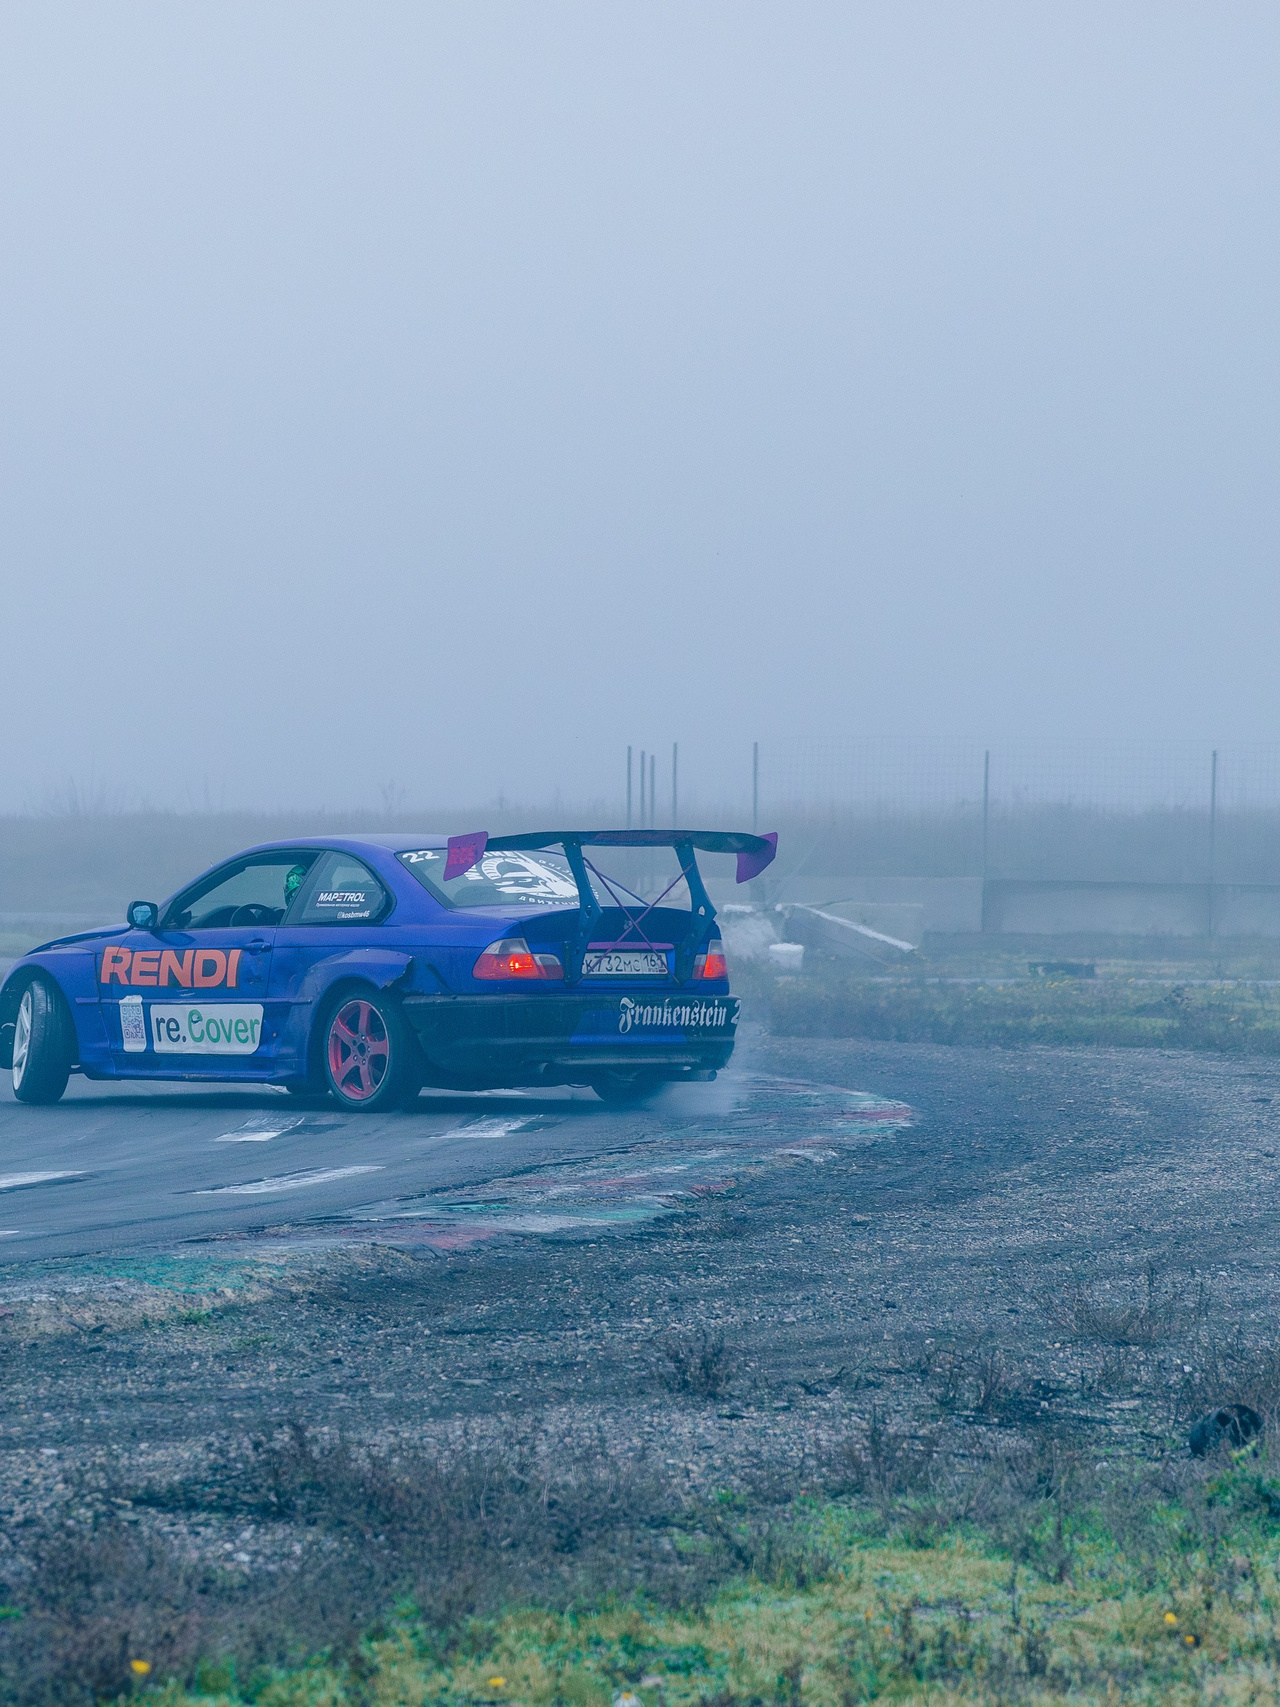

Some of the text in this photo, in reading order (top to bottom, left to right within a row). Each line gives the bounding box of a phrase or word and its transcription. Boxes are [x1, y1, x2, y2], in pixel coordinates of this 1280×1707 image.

[402, 850, 439, 864] 22
[317, 892, 365, 902] MAPETROL
[101, 946, 242, 988] RENDI
[619, 997, 727, 1034] Frankenstein
